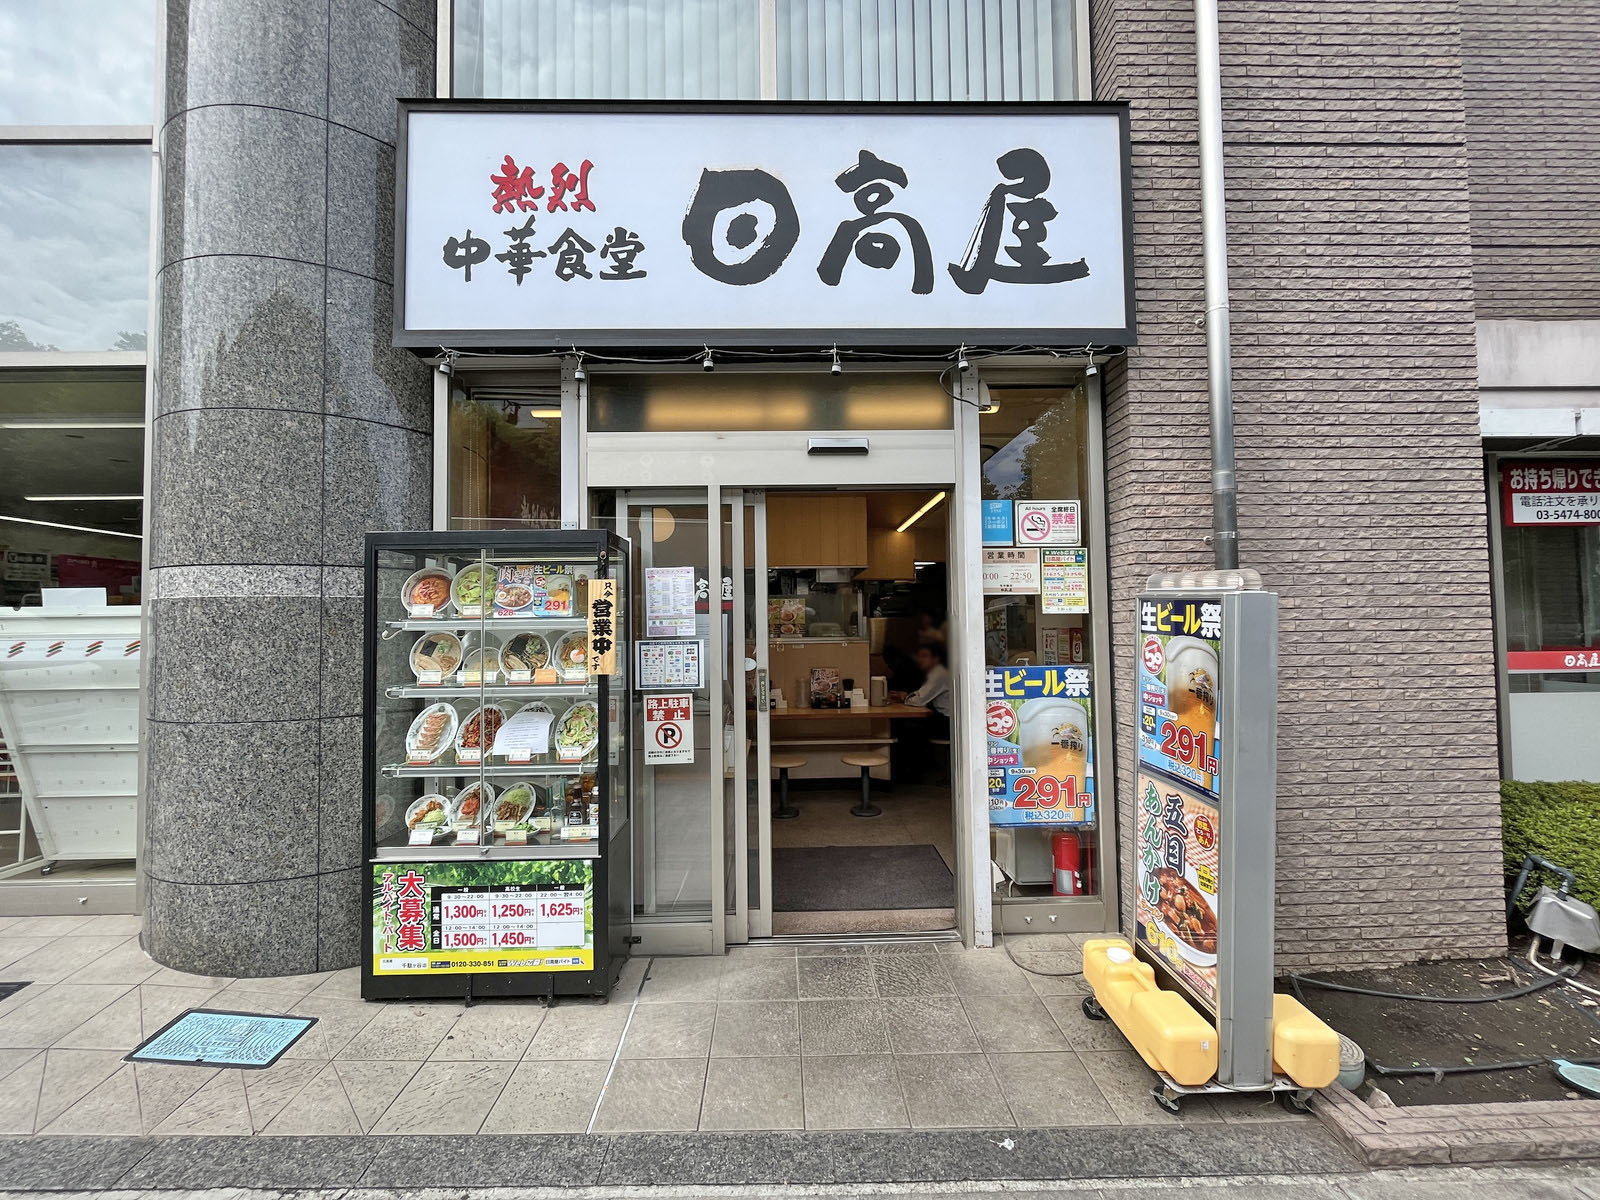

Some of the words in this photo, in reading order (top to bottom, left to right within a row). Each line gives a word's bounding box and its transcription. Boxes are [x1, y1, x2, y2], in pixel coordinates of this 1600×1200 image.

[491, 154, 596, 213] 熱烈
[683, 148, 1091, 294] 日高屋
[443, 215, 647, 287] 中華食堂
[1051, 513, 1076, 525] 禁煙
[986, 552, 1026, 560] 営業時間
[1010, 572, 1032, 580] 22:50
[1141, 601, 1221, 639] 生ビール祭
[985, 668, 1090, 697] 生ビール祭
[647, 698, 690, 710] 路上駐車
[1050, 739, 1084, 752] 一番搾り
[1161, 721, 1219, 776] 291円
[1013, 776, 1092, 809] 291円
[1143, 781, 1162, 905] あんかけ
[399, 871, 425, 950] 大募集
[451, 960, 494, 968] 0120-330-851
